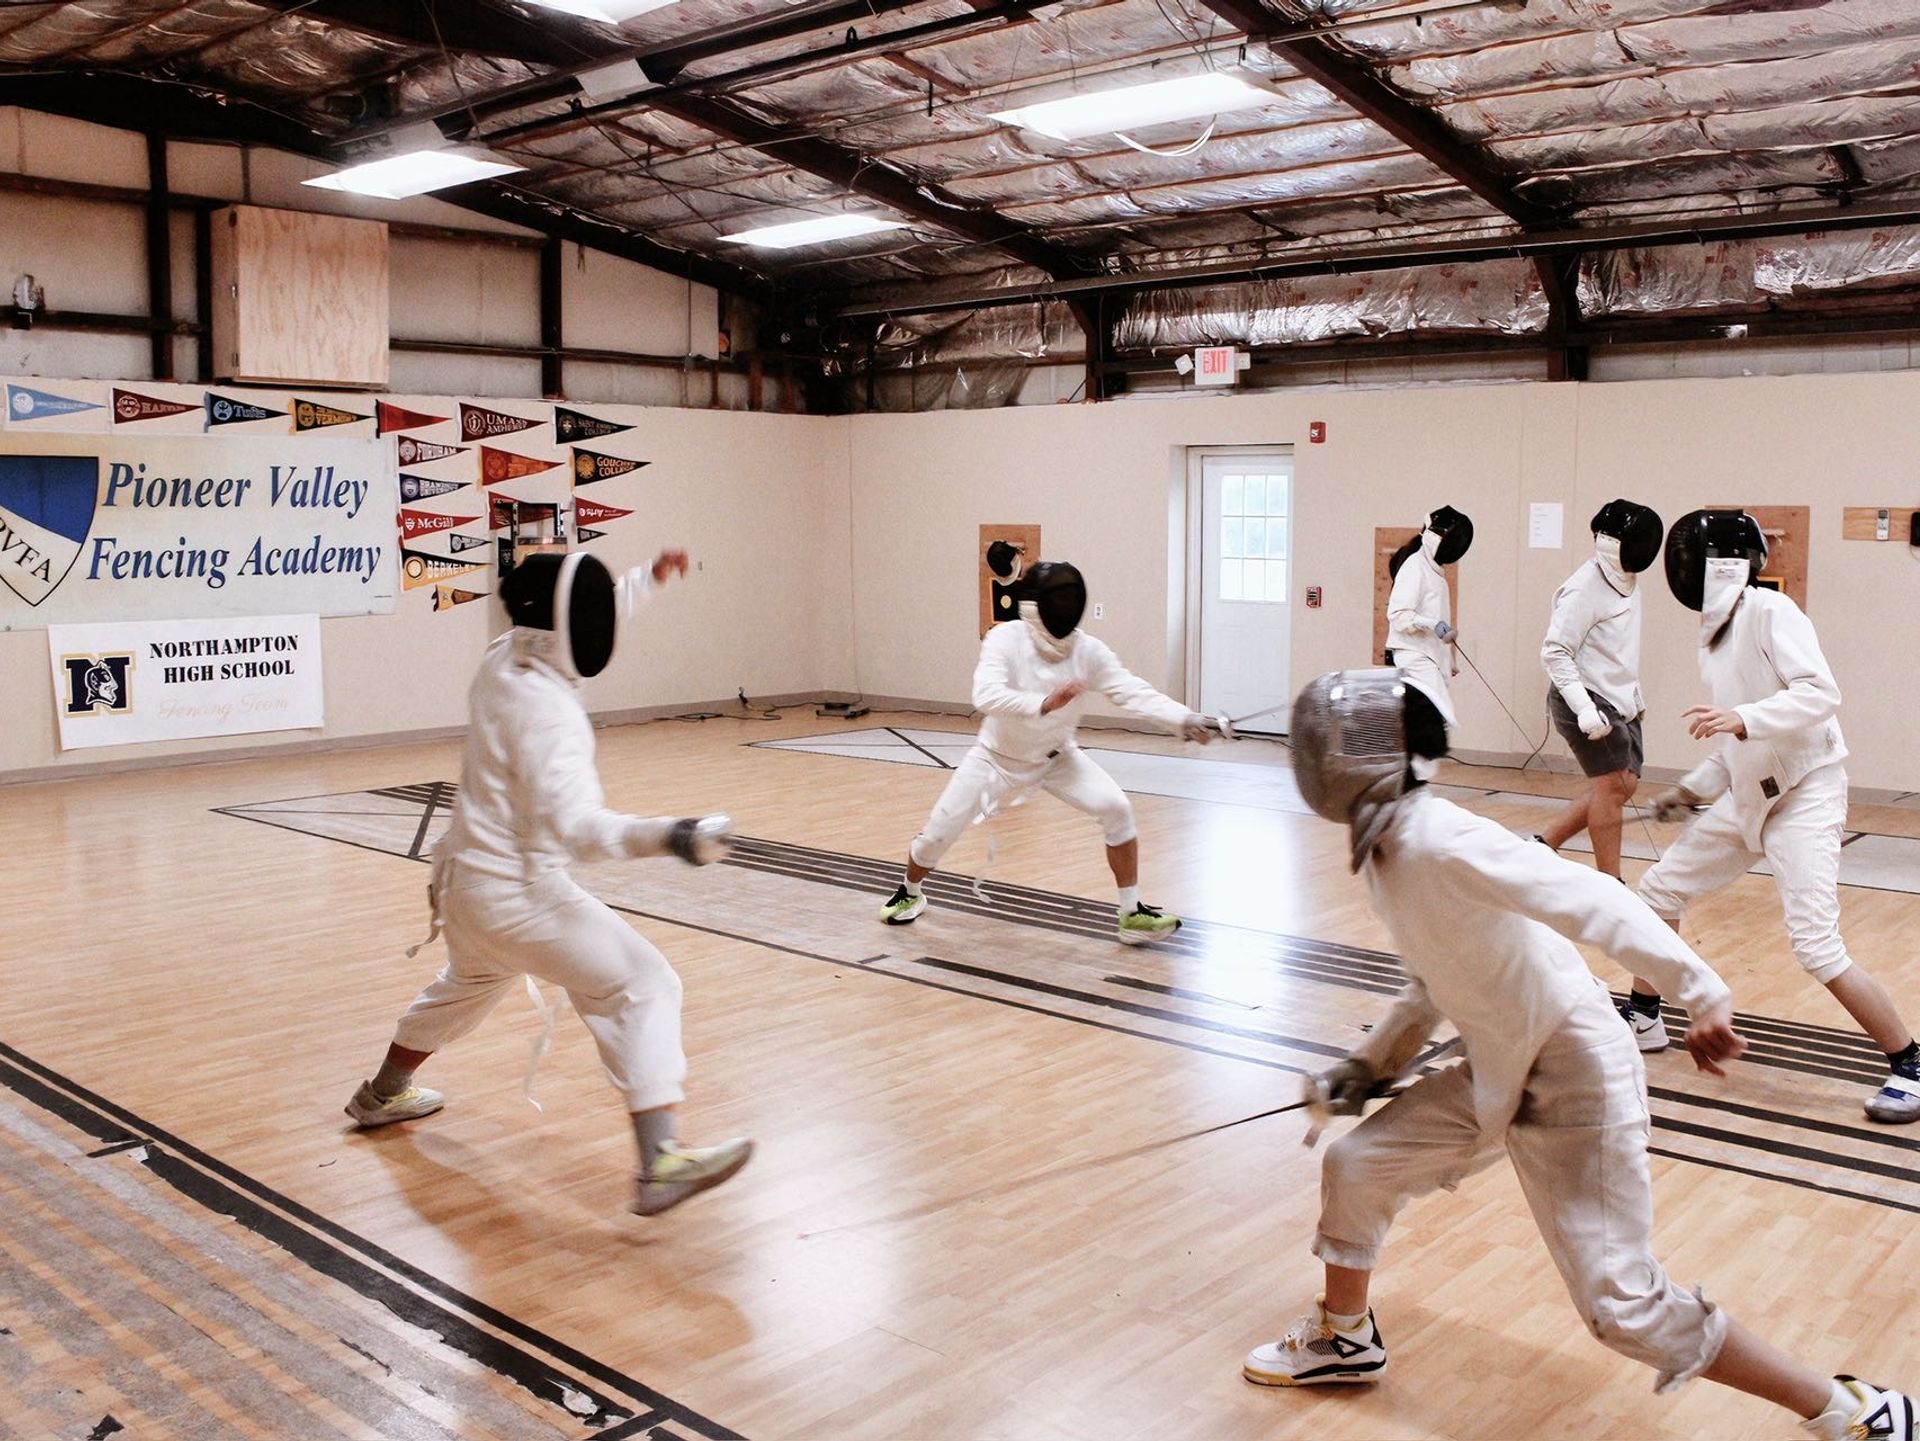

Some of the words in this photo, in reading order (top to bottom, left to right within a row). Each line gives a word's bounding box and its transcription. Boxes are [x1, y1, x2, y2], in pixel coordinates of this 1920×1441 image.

[1203, 350, 1227, 373] EXIT
[102, 462, 251, 508] Pioneer
[269, 465, 369, 519] Valley
[417, 516, 454, 529] McGill
[86, 536, 230, 588] Fencing
[237, 534, 381, 583] Academy
[150, 635, 298, 658] NORTHAMPTON
[164, 665, 214, 684] HIGH
[220, 660, 295, 680] SCHOOL
